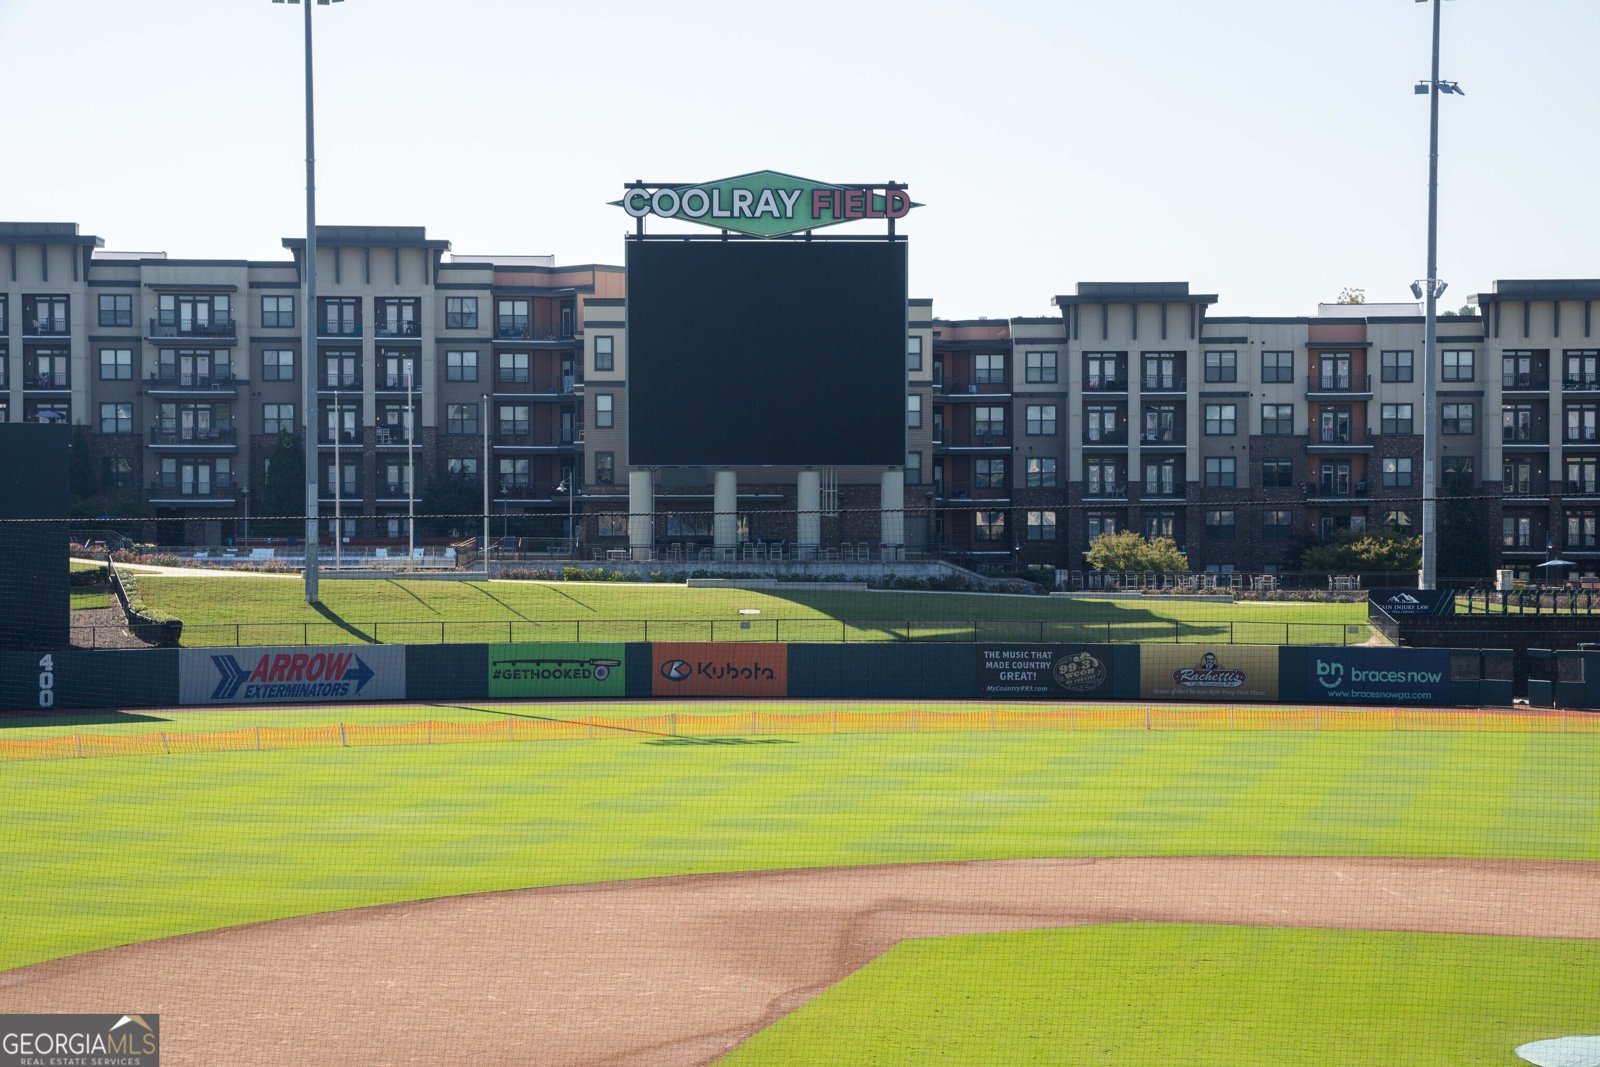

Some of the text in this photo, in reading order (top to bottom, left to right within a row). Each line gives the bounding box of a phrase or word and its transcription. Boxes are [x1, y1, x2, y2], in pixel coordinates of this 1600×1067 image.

[622, 188, 911, 219] COOLRAY FIELD
[984, 651, 1053, 659] THE MUSIC THAT
[248, 652, 353, 682] ARROW
[697, 662, 774, 680] Kubota
[985, 661, 1051, 669] MADE COUNTRY
[1059, 659, 1091, 675] 99.3
[1316, 659, 1344, 676] bn
[39, 653, 54, 707] 400
[493, 668, 592, 680] #GETHOOKED
[999, 671, 1037, 681] GREAT!
[1064, 667, 1095, 679] WCON
[244, 682, 349, 698] EXTERMINATORS
[986, 685, 1048, 693] MyCountry993.com
[1327, 689, 1432, 700] www.bracesnowga.com
